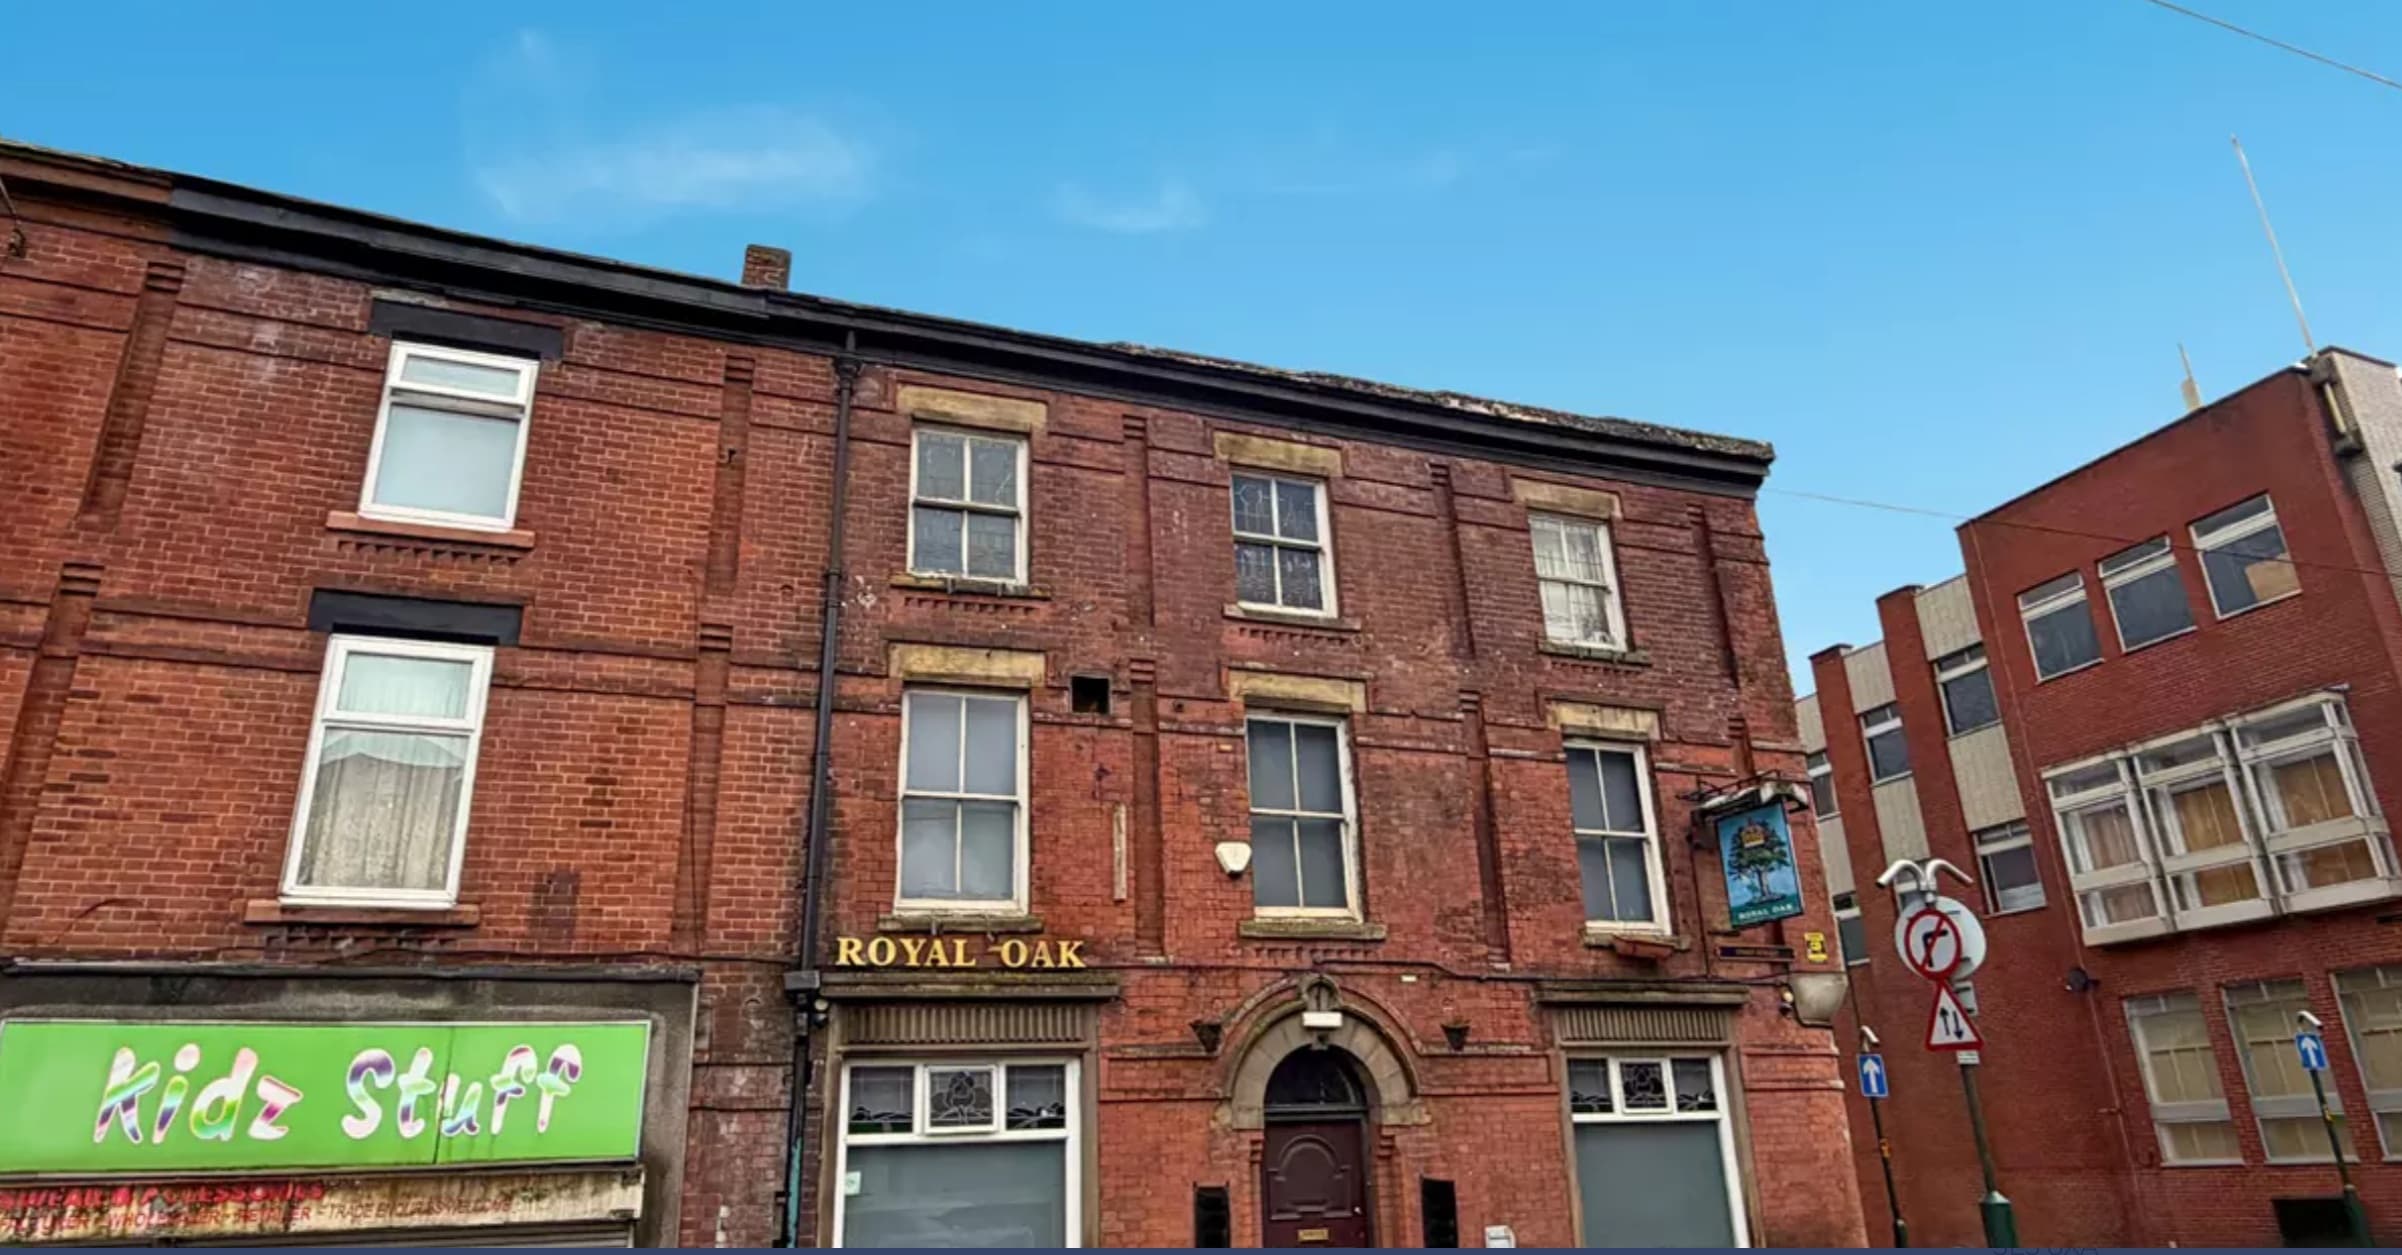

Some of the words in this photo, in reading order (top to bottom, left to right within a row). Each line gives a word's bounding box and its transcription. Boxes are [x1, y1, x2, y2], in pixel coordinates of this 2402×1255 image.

[836, 937, 976, 966] ROYAL
[1001, 939, 1086, 968] OAK
[93, 1043, 303, 1145] Kidz
[341, 1043, 583, 1141] Stuff
